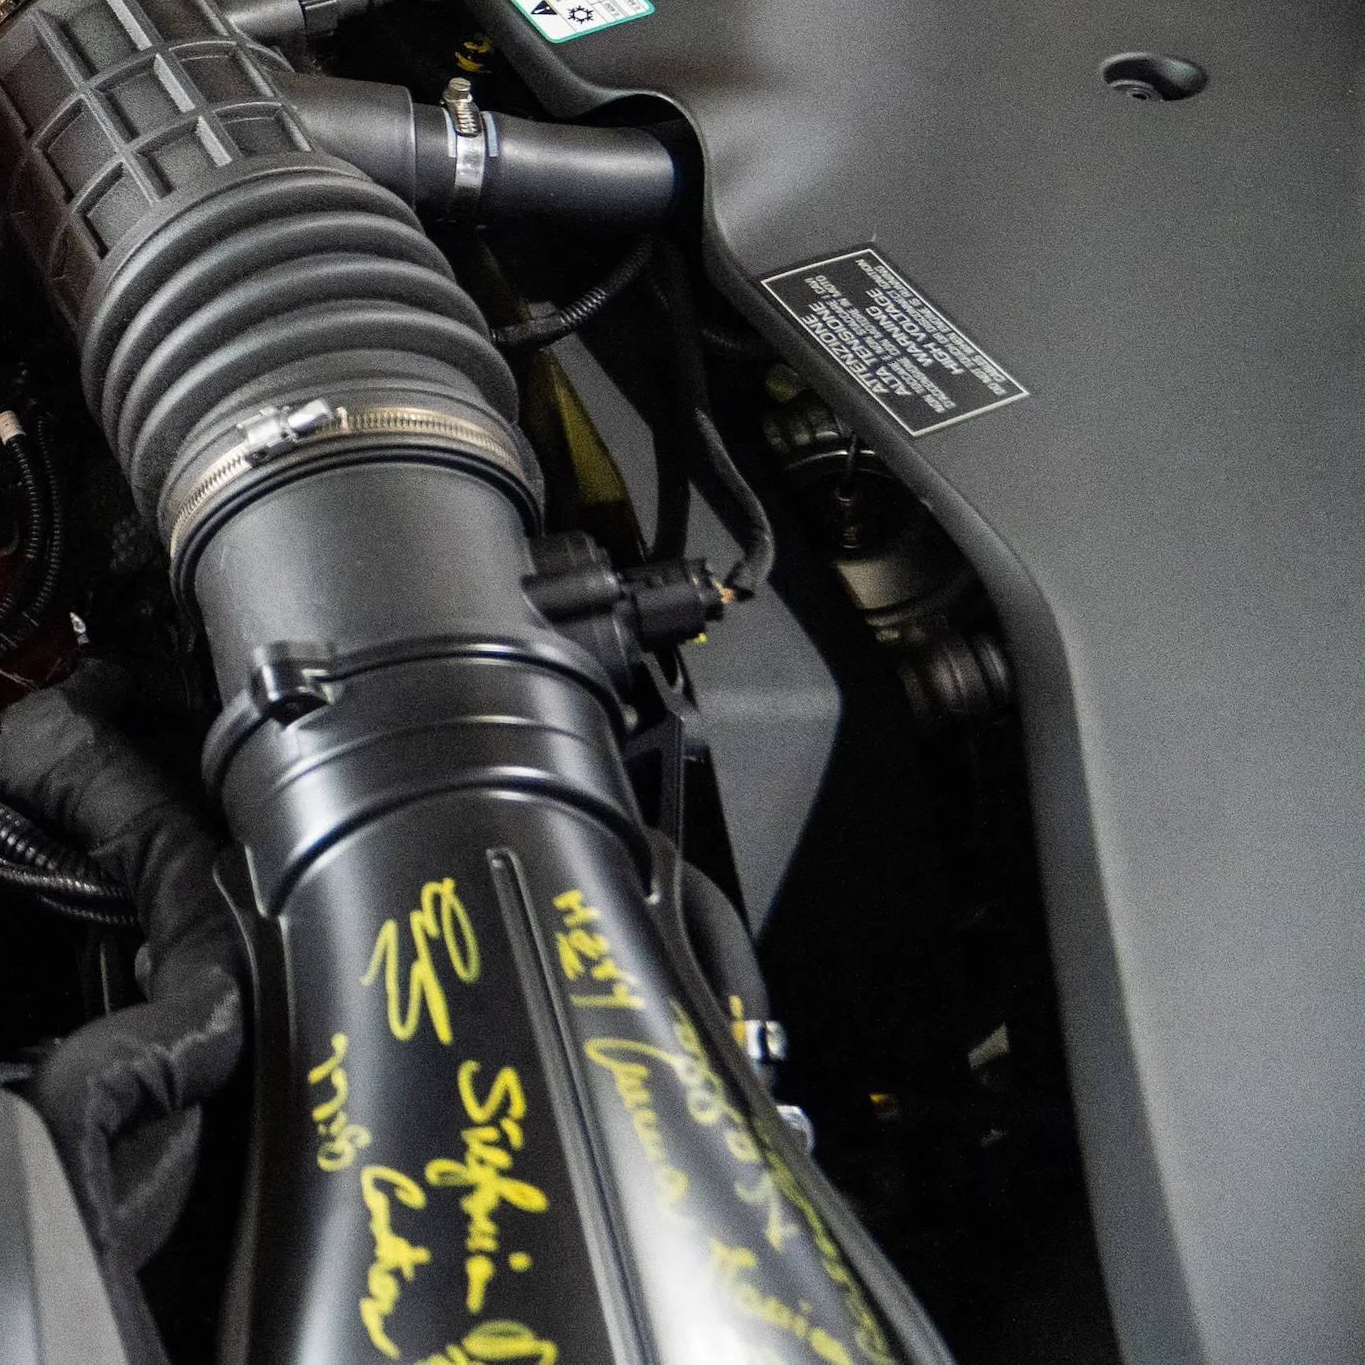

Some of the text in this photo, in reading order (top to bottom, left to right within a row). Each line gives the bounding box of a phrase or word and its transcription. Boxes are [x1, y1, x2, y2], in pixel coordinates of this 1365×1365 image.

[799, 312, 891, 396] ATTENZIONE
[807, 300, 913, 398] ALTA TENSIONE
[862, 304, 936, 367] WARNING
[864, 287, 966, 375] HIGH VOLTAGE
